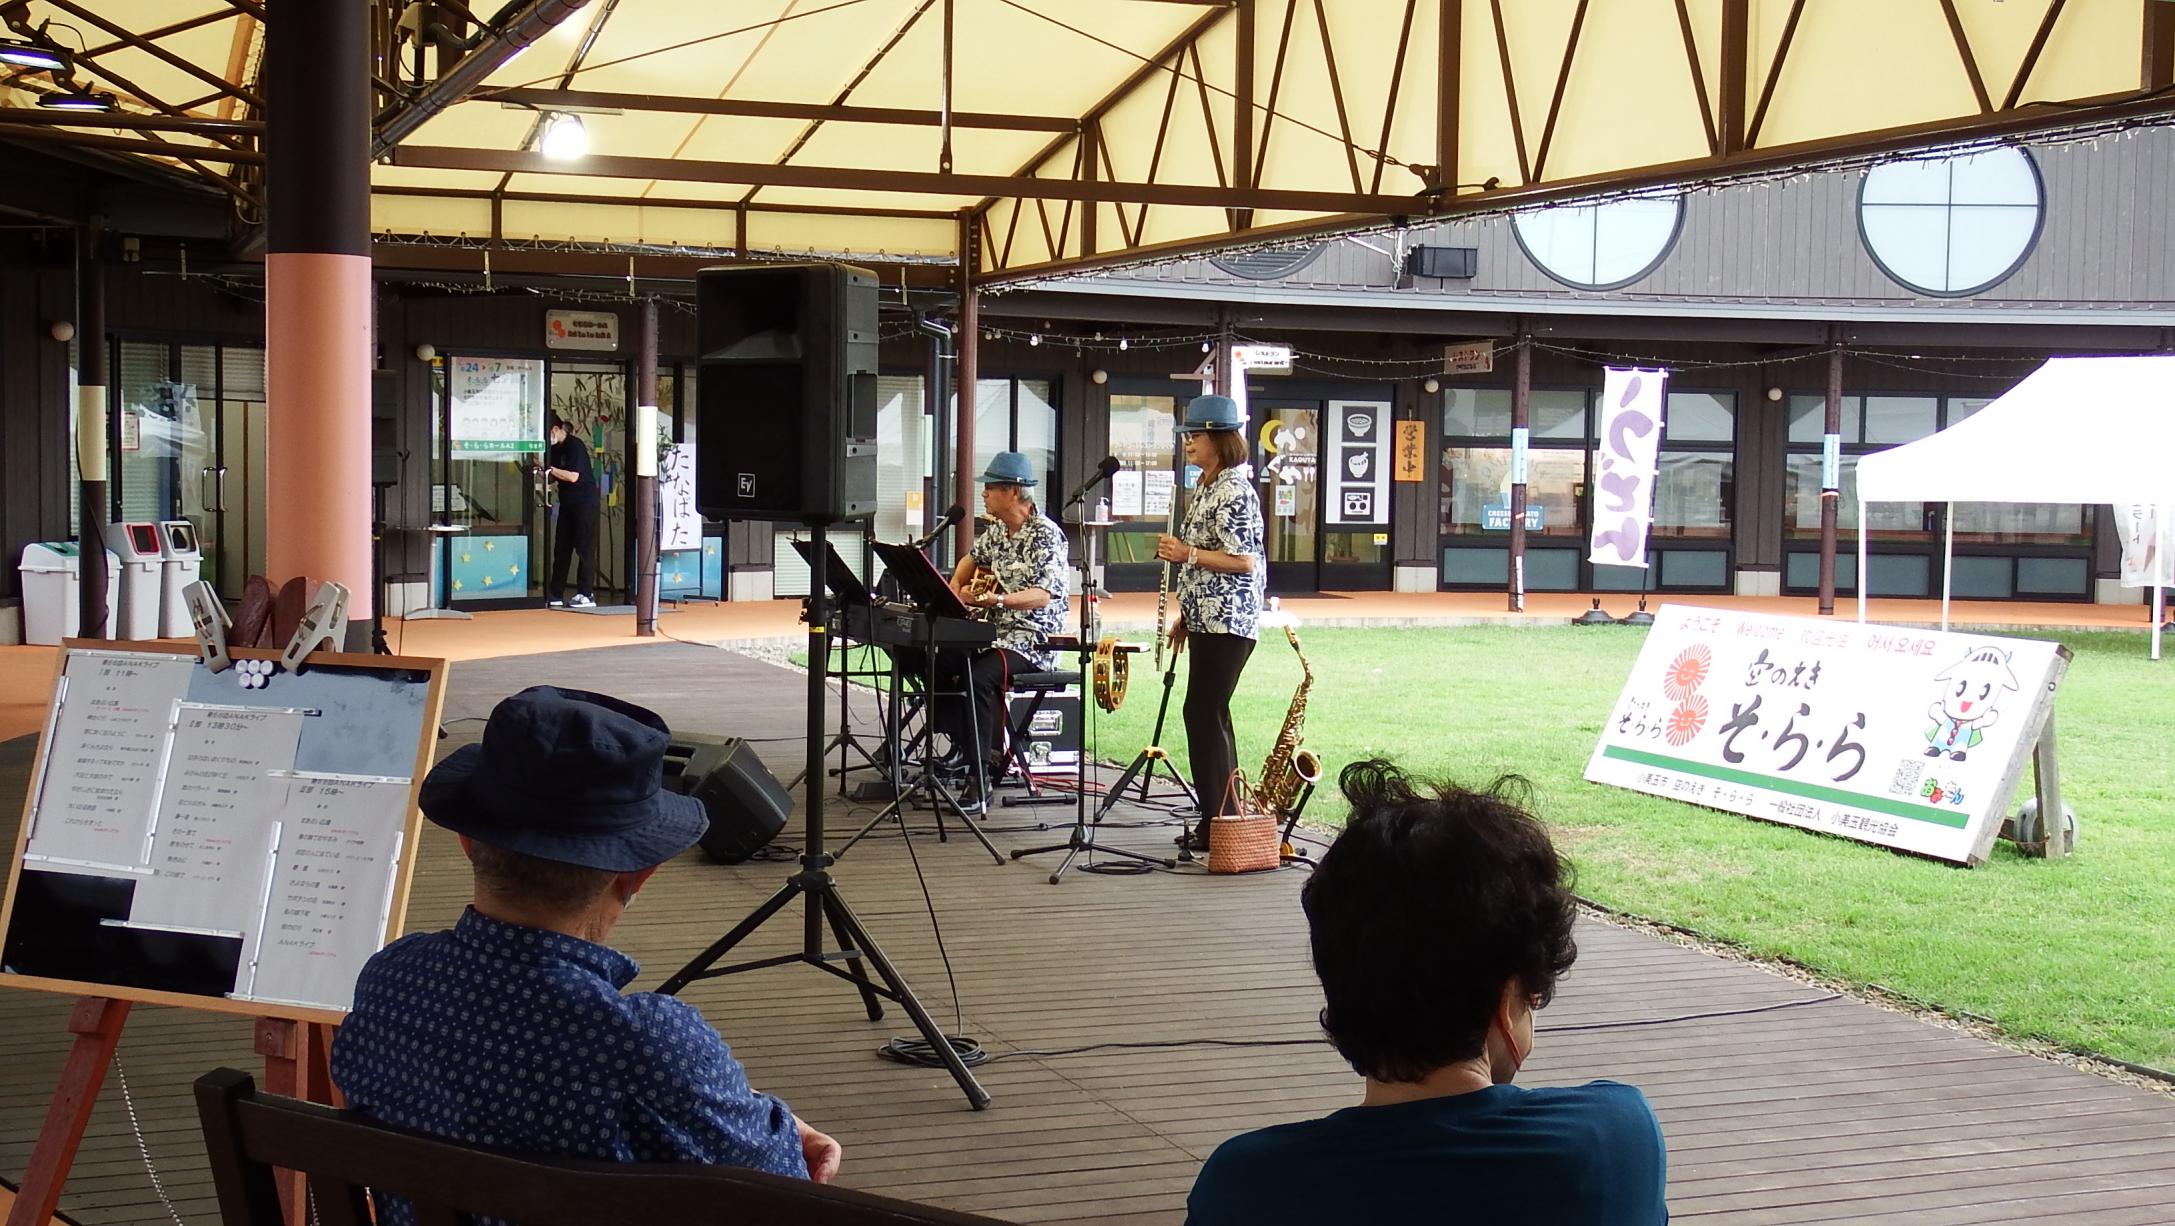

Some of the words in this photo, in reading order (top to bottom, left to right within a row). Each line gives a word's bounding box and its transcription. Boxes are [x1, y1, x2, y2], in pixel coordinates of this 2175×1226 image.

[671, 445, 690, 546] たなばた
[1489, 518, 1539, 528] FACRY
